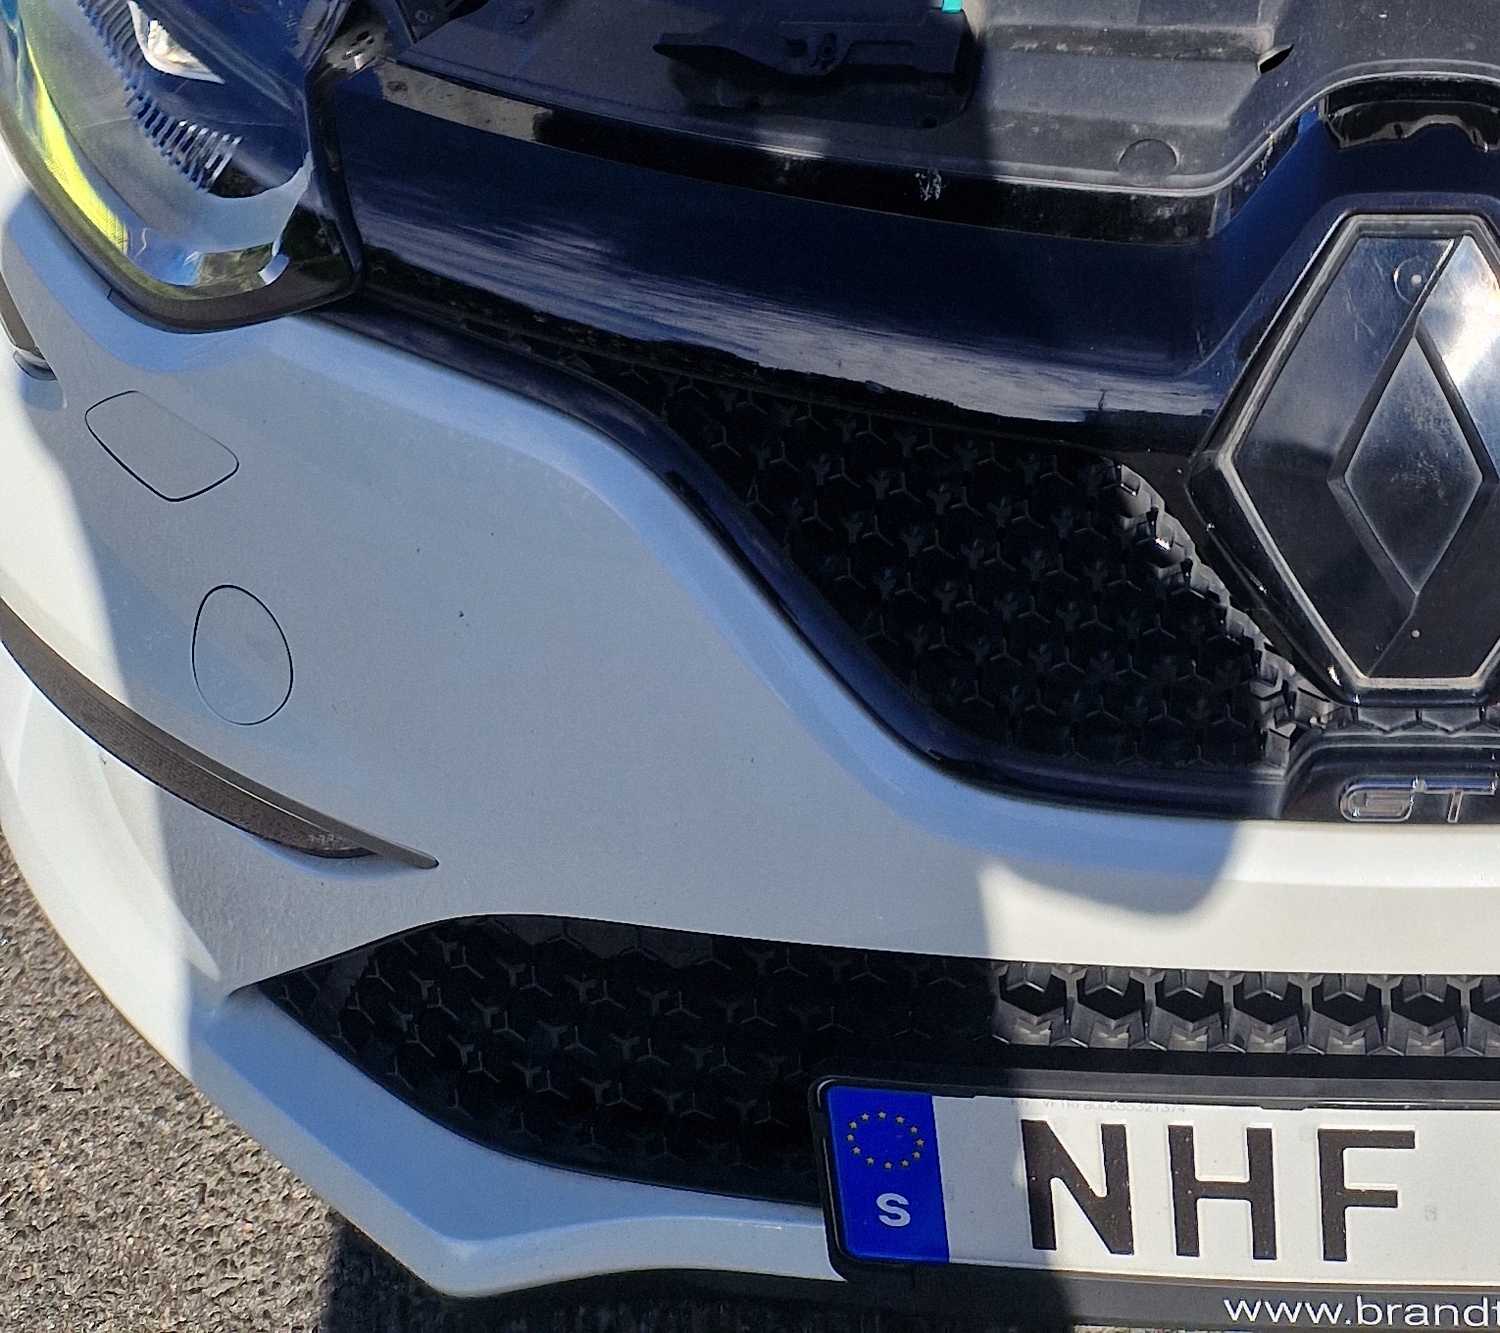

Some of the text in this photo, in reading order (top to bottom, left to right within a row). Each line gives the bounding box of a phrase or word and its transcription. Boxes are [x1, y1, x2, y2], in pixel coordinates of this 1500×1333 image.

[1339, 775, 1499, 824] GT
[875, 1192, 912, 1227] S
[1020, 1119, 1416, 1263] NHF
